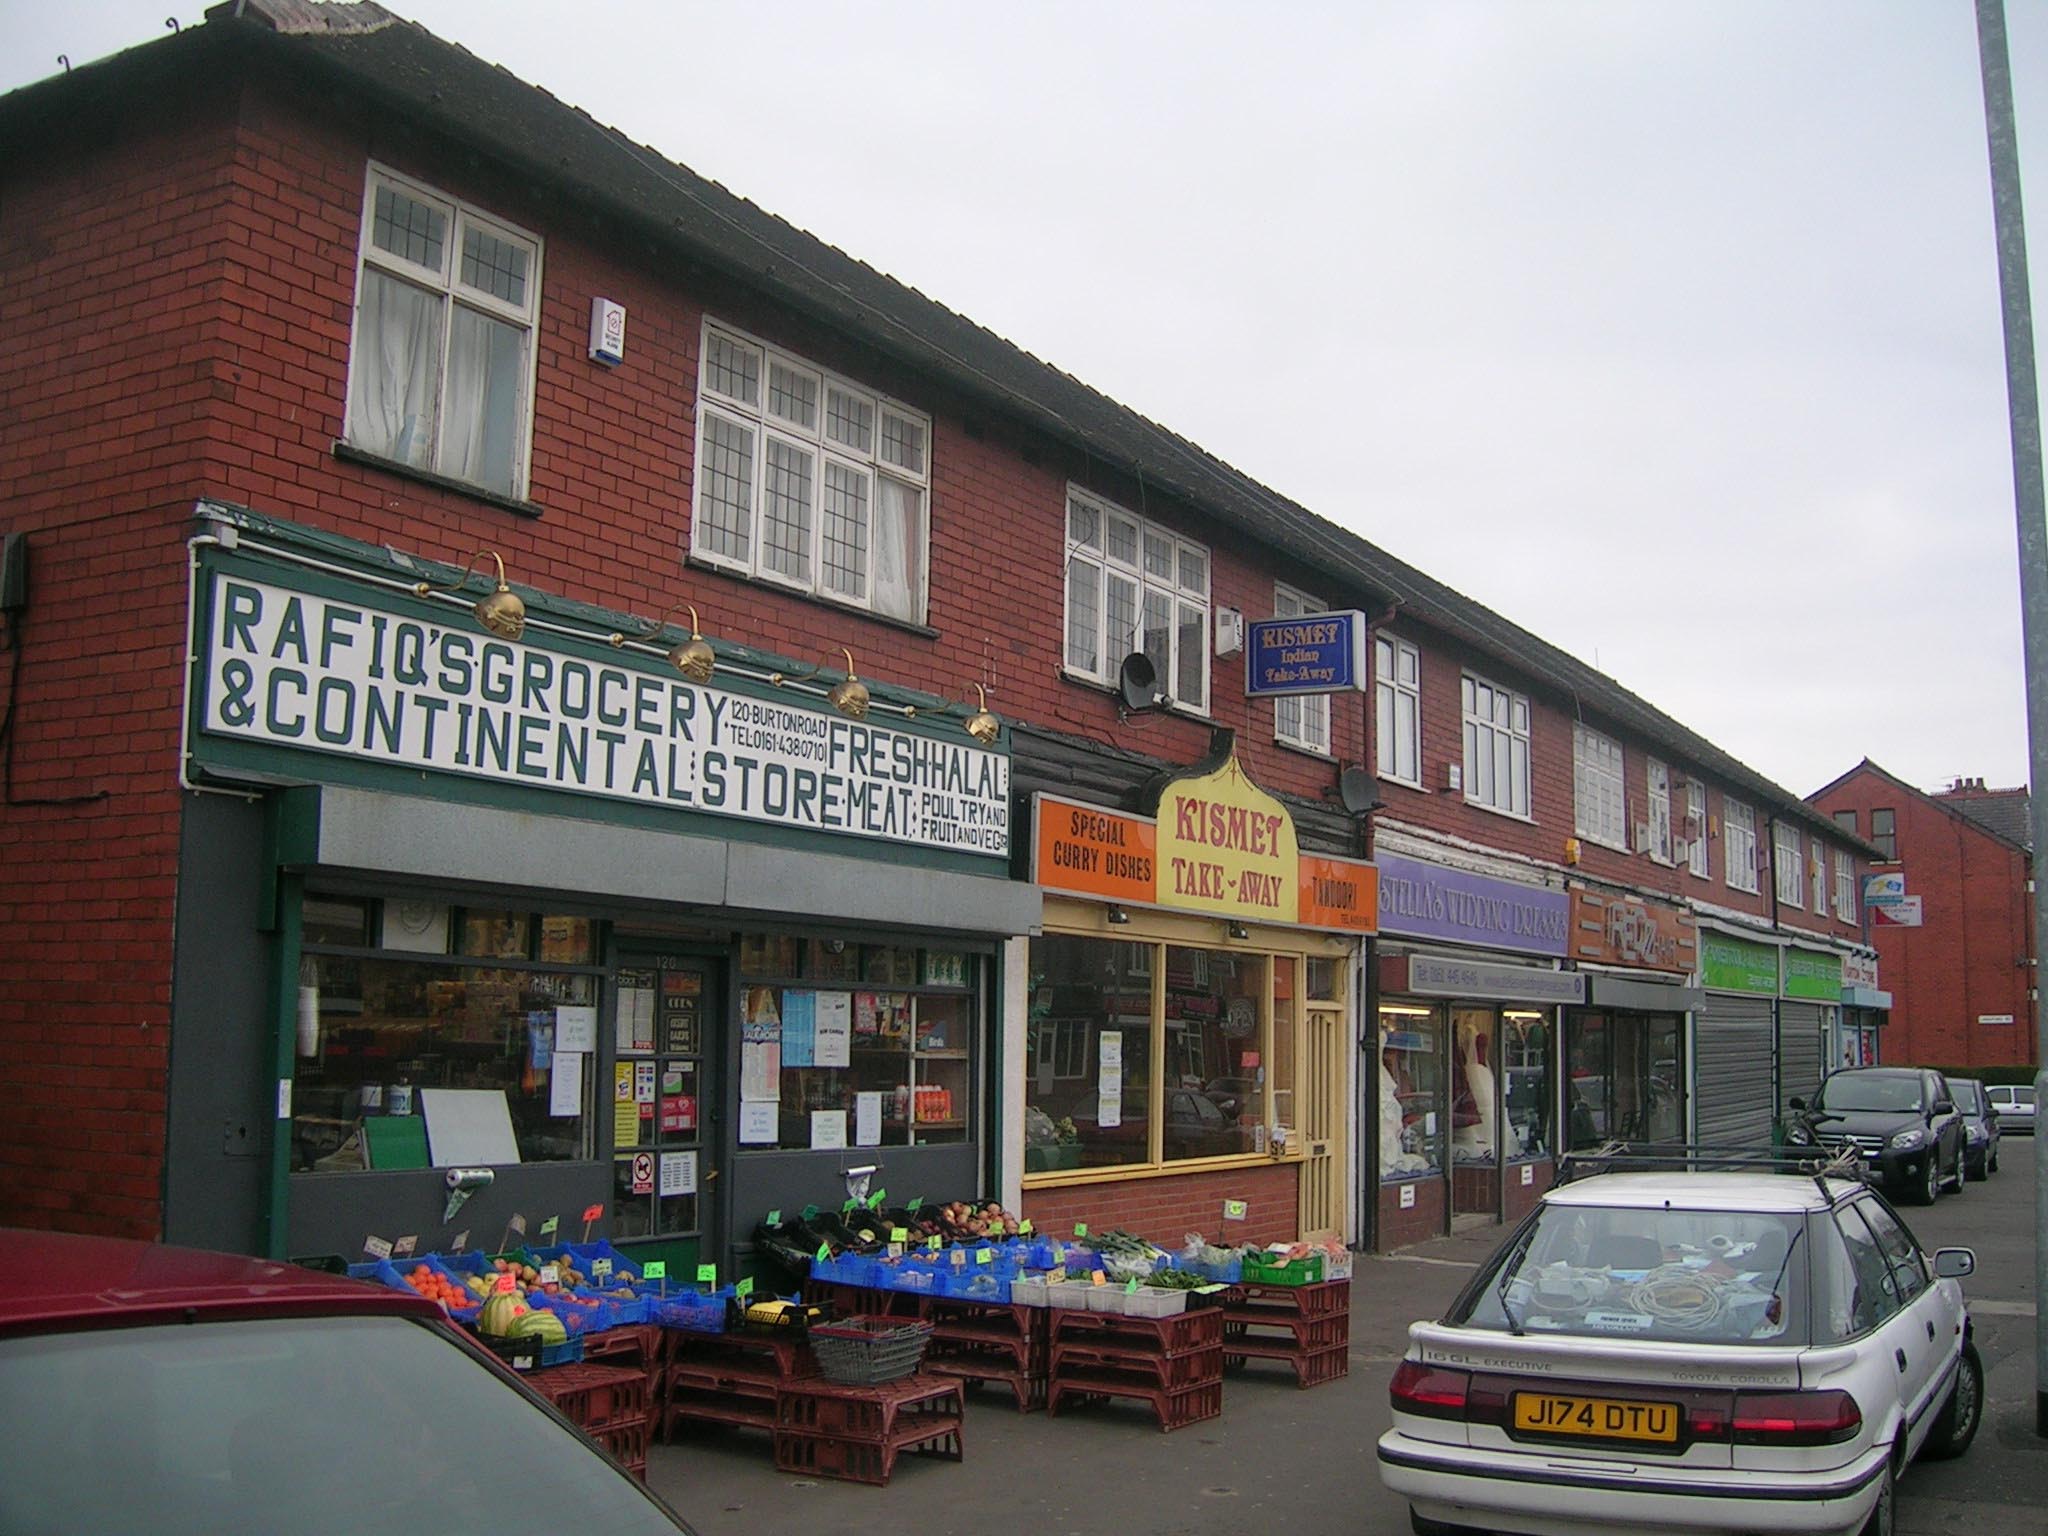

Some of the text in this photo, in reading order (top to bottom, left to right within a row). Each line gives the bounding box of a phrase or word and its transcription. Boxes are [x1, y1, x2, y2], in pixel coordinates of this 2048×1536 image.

[1262, 623, 1339, 648] KISMET
[222, 581, 728, 746] RAFIQ'S GROCERY
[1281, 649, 1320, 664] Indian
[265, 666, 693, 801] CONTINENTAL
[701, 751, 843, 827] STORE
[829, 721, 1006, 803] FRESH HALAL
[1070, 811, 1127, 847] SPECIAL
[1175, 795, 1284, 858] KISMET
[1053, 840, 1152, 883] CURRY DISHES
[1312, 876, 1357, 911] TANDOORI
[1379, 875, 1569, 941] STELLA'S WEDDING DRESSES
[1483, 1358, 1553, 1372] EXECUTIVE
[1671, 1369, 1790, 1385] TOYOTA COROLLA
[1528, 1399, 1667, 1434] J174 DTU
